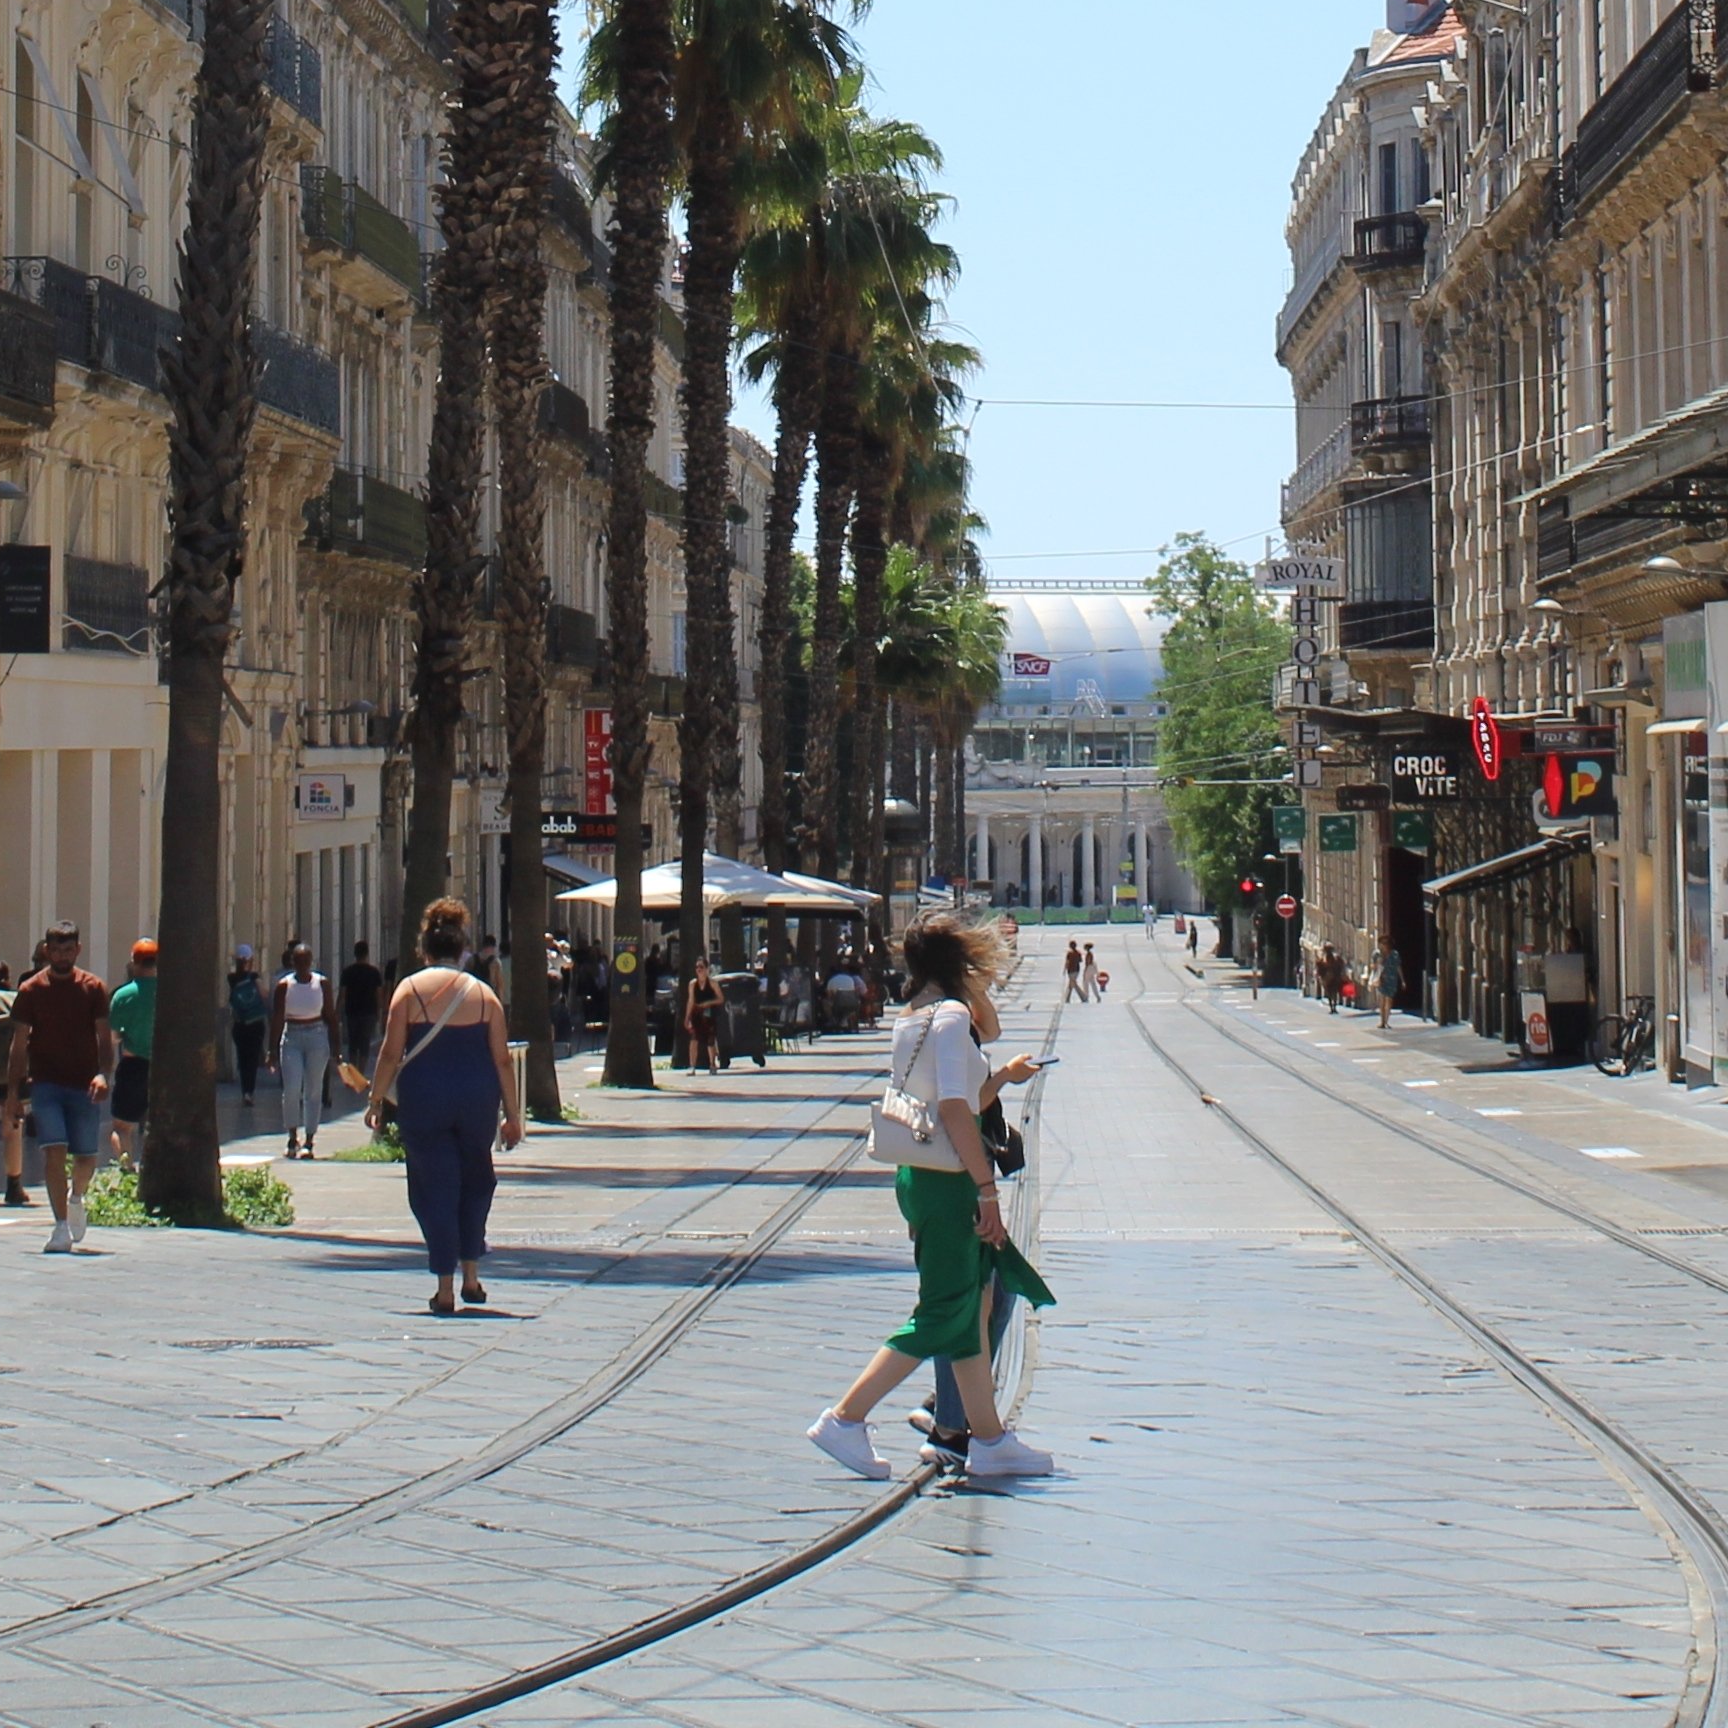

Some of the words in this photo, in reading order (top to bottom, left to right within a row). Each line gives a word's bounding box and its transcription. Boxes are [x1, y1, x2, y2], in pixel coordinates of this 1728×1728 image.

[1272, 561, 1337, 582] ROYAL
[1015, 660, 1049, 674] SNCF
[1293, 598, 1319, 787] HOTEL
[1394, 755, 1447, 776] CROC
[303, 804, 340, 813] FONCIA
